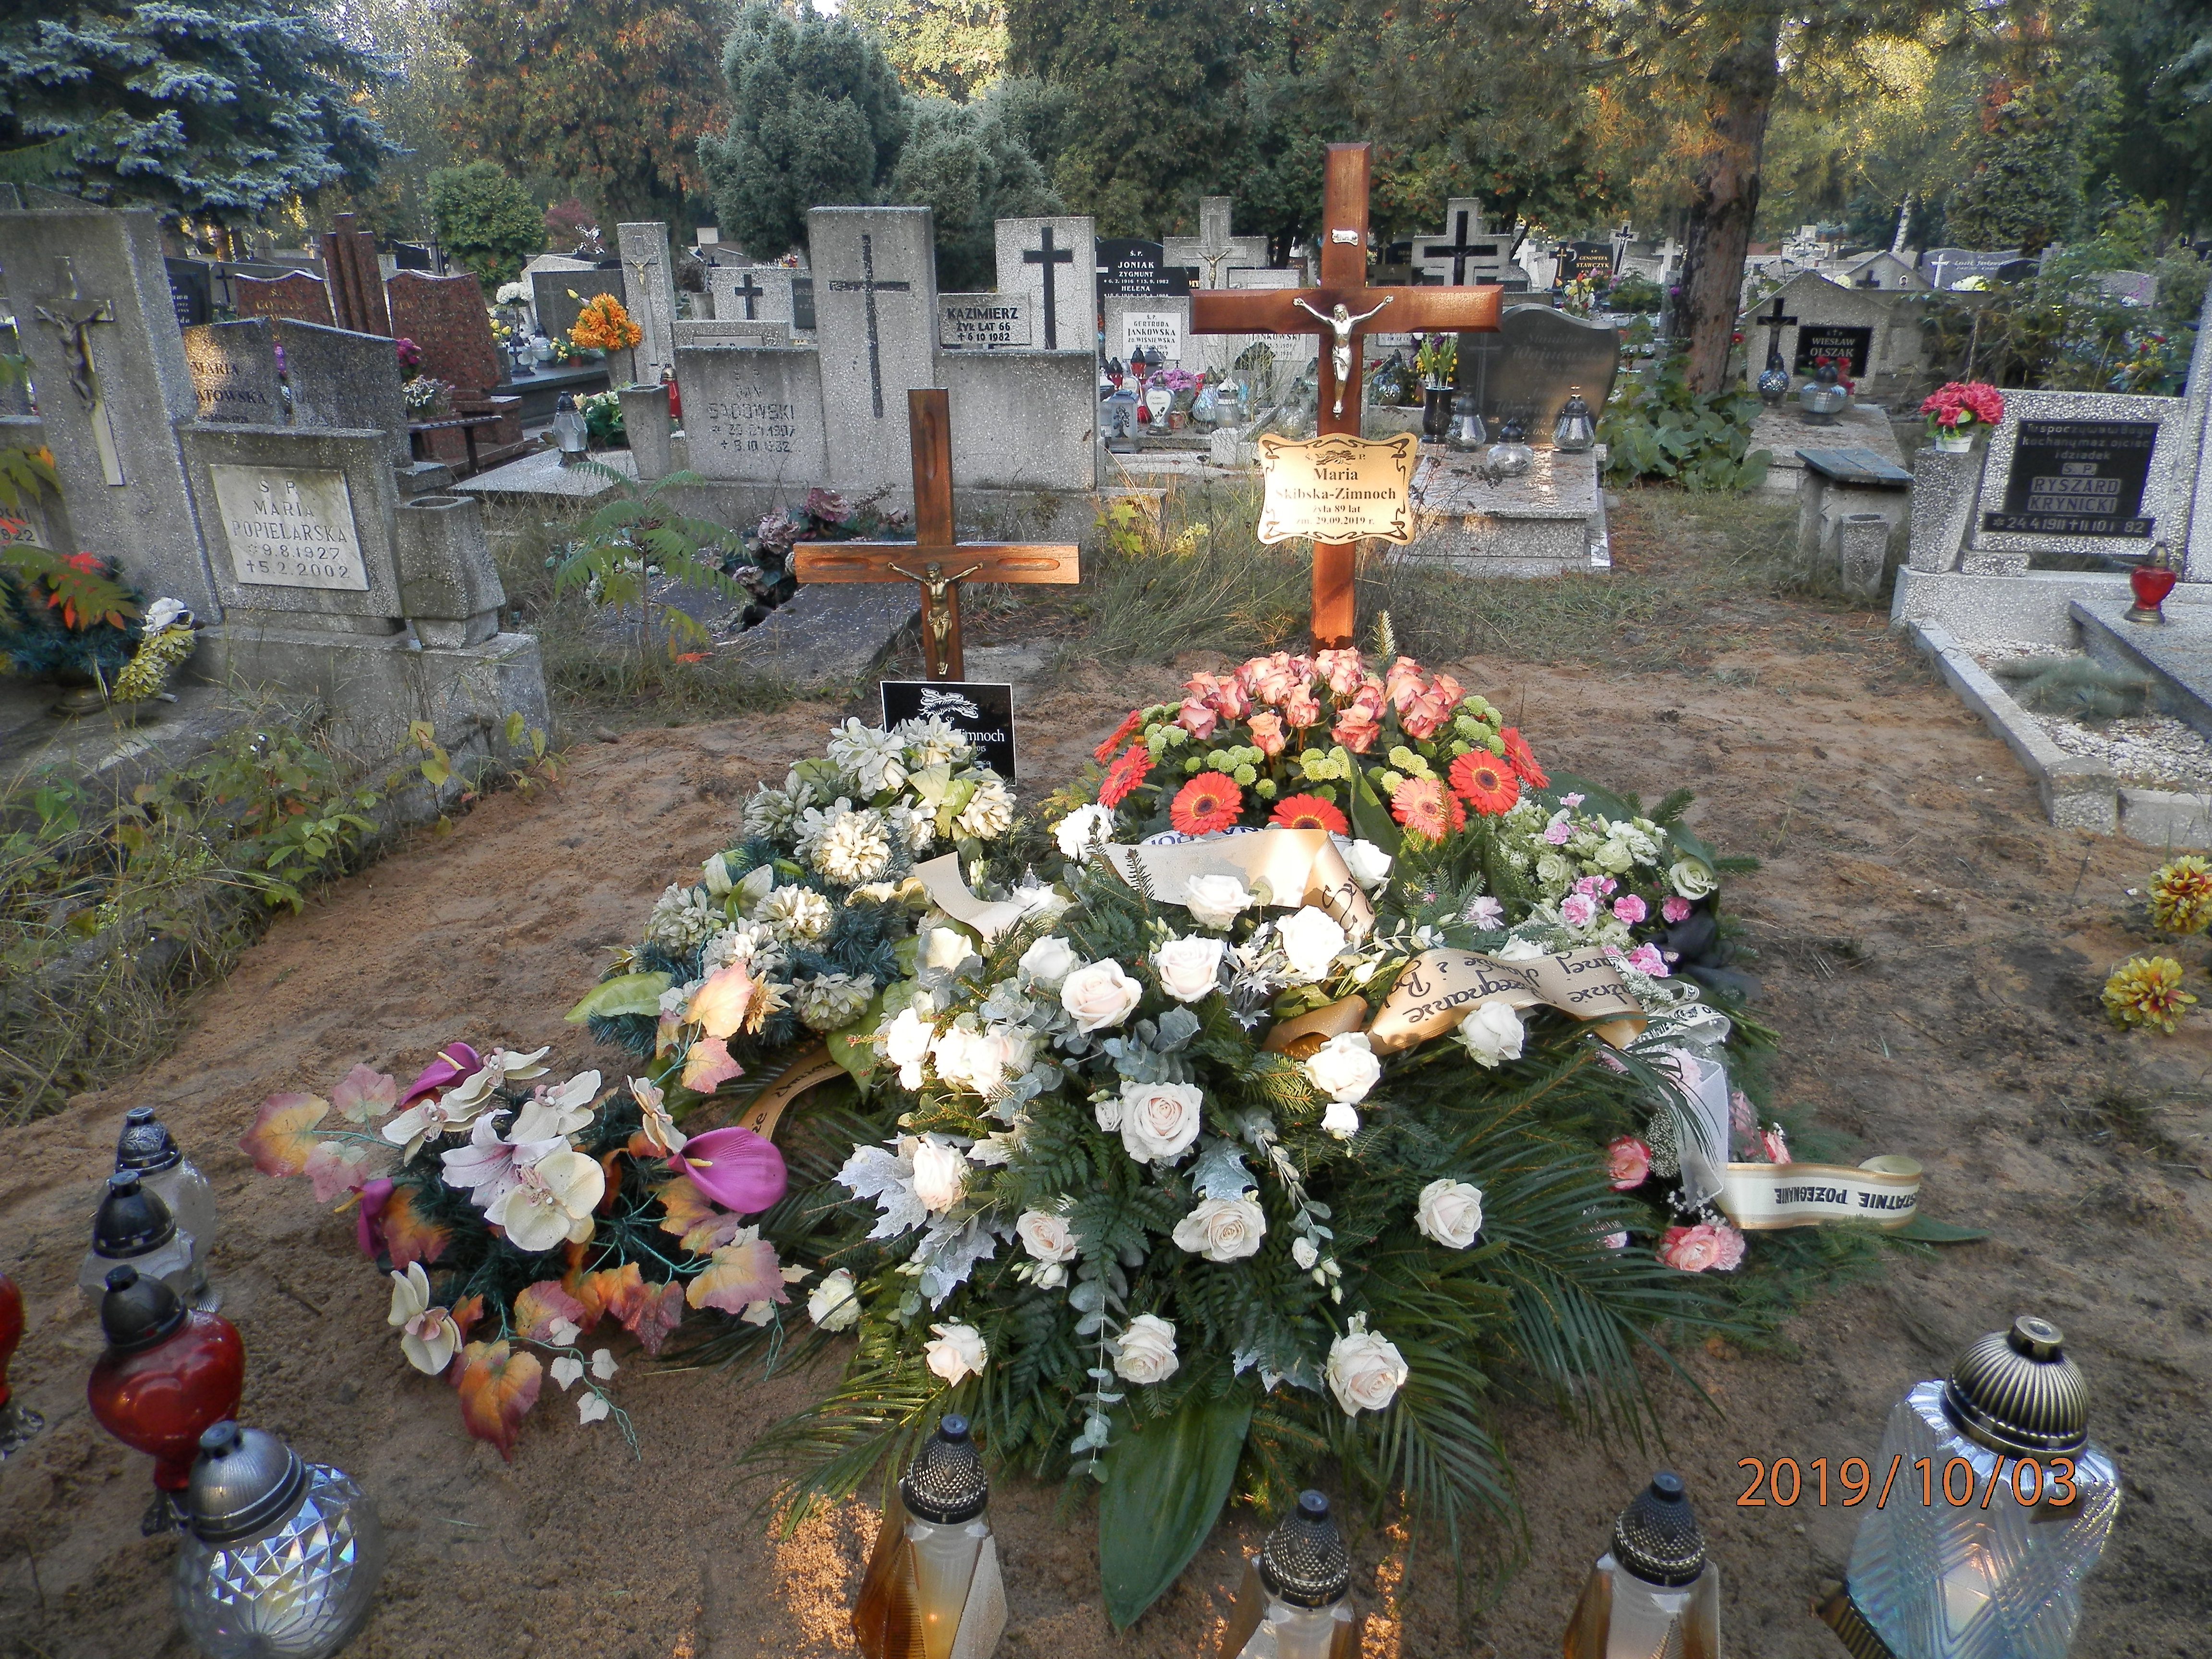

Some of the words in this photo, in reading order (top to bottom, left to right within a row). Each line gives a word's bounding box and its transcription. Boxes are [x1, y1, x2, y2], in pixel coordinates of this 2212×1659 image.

[947, 307, 1019, 319] KAZIMIERZ
[978, 322, 995, 331] LAT
[999, 322, 1010, 331] 66
[989, 332, 1010, 341] 1982
[1812, 337, 1856, 346] WIESŁAW
[1810, 347, 1855, 357] OLSZAK
[190, 361, 239, 377] MARIA
[2022, 436, 2077, 448] kochany
[2061, 450, 2111, 460] dziadek
[1314, 468, 1358, 480] Maria
[2034, 479, 2119, 493] RYSZARD
[1275, 487, 1396, 500] Skibska-Zimnoch
[253, 500, 314, 517] MARIA
[1348, 505, 1360, 513] lat
[2031, 496, 2116, 513] KRYNICKI
[1316, 517, 1365, 525] 29.09.2019
[230, 520, 348, 543] POPIELARSKA
